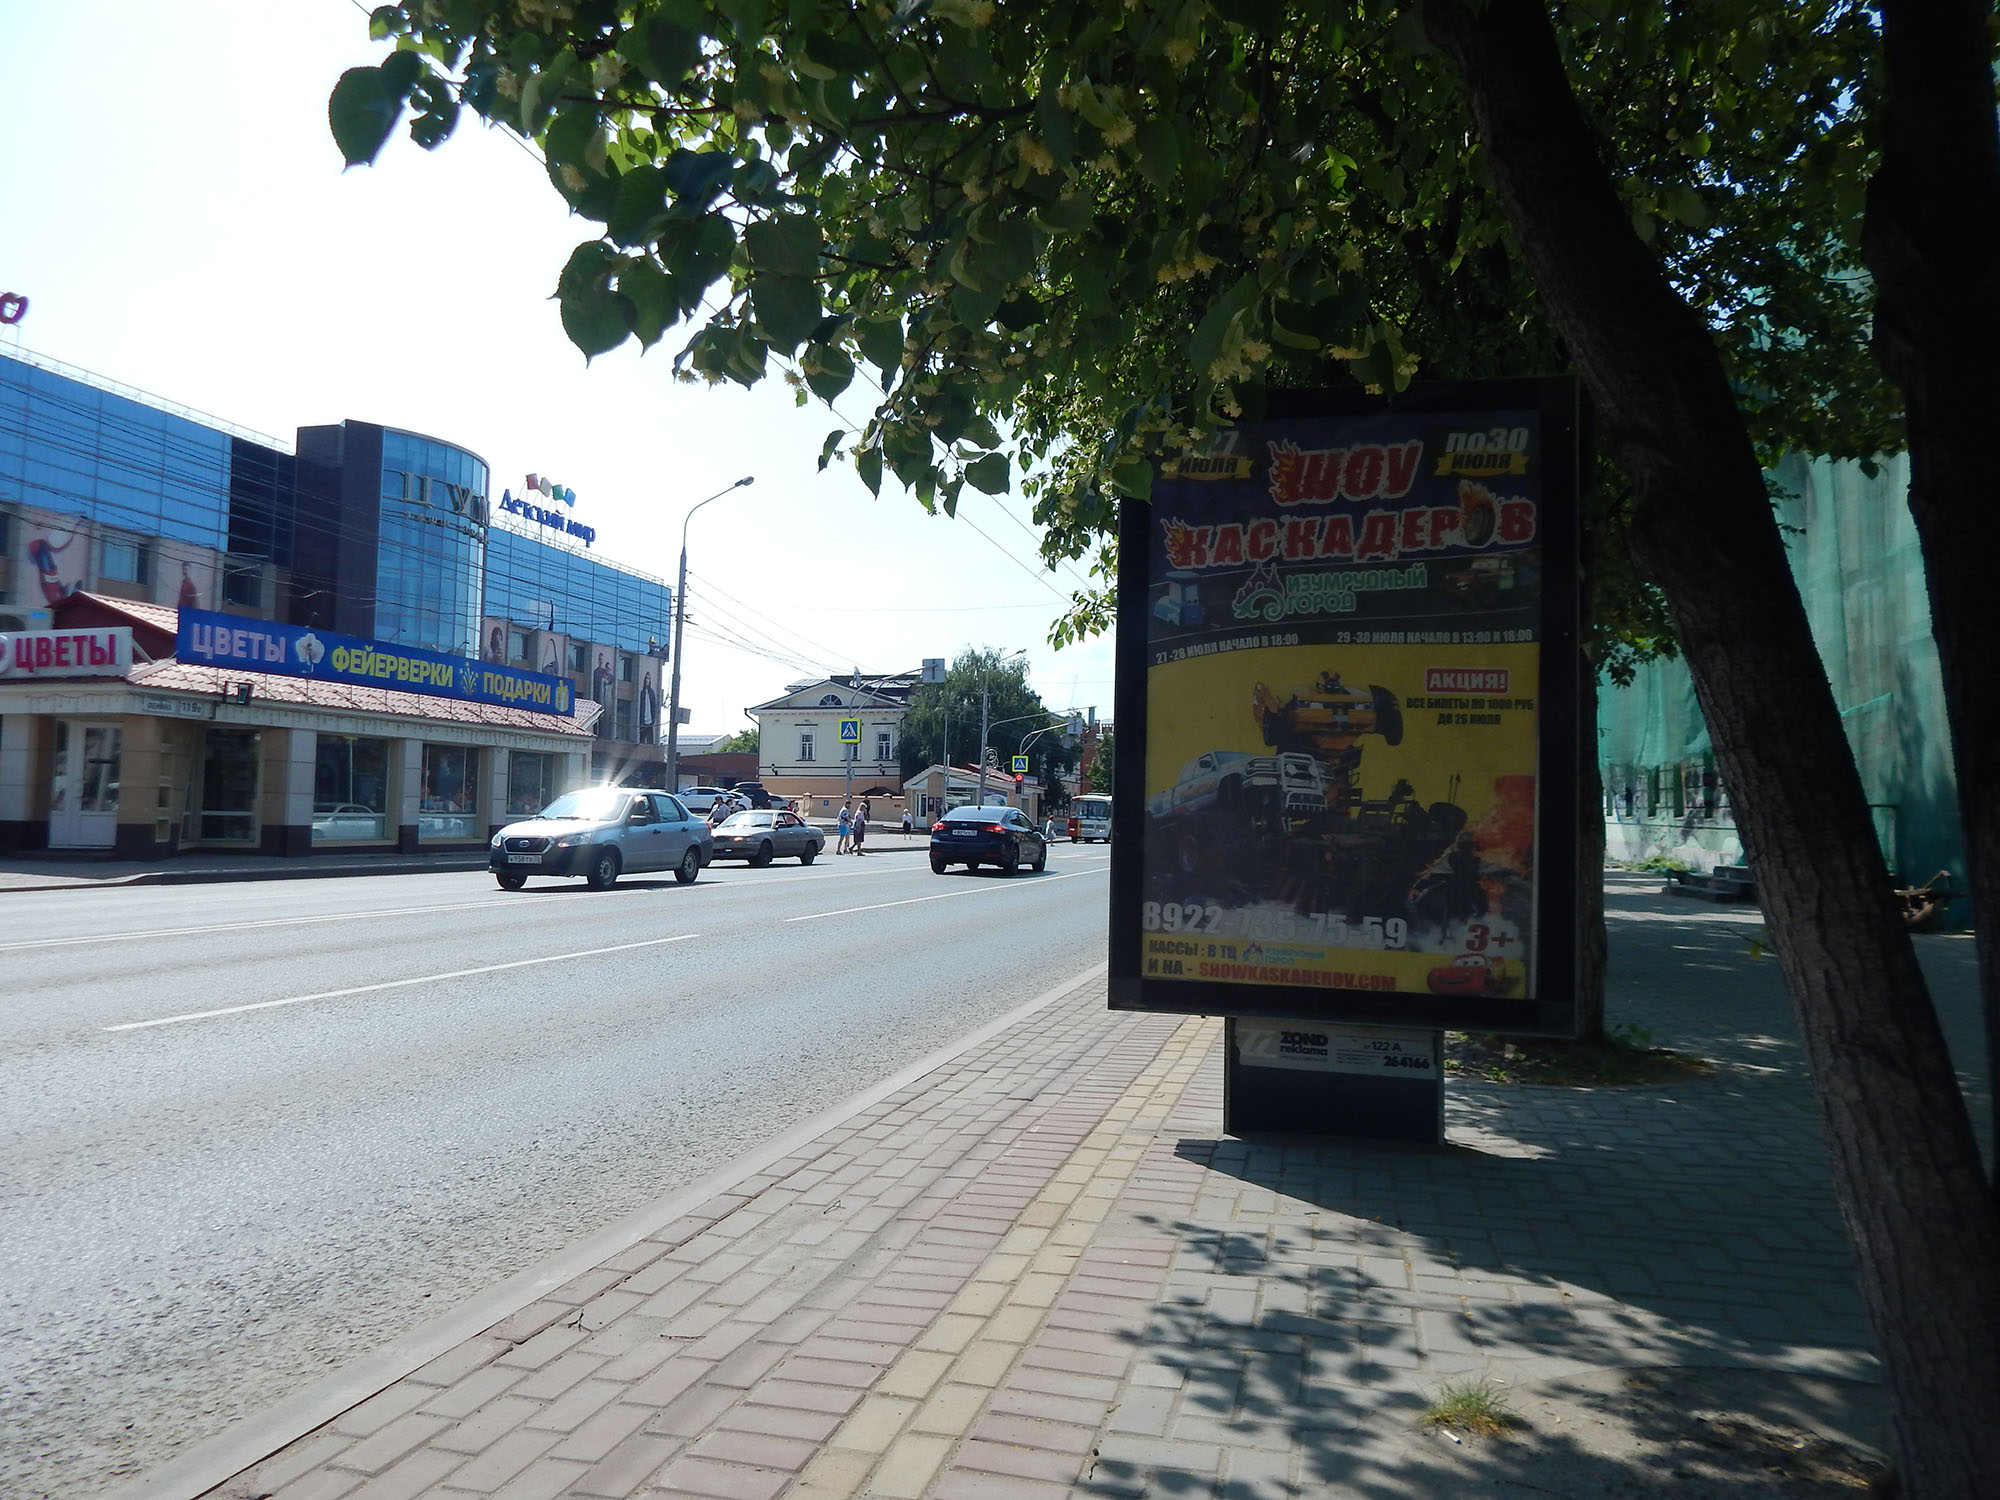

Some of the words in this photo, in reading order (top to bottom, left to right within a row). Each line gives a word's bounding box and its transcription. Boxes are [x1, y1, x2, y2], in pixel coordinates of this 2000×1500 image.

[1445, 427, 1529, 453] по30
[1179, 458, 1238, 472] ИЮЛЯ
[1452, 454, 1512, 469] ИЮЛЯ
[1267, 439, 1423, 506] ШОУ
[499, 489, 565, 530] Детский
[566, 519, 596, 548] мир
[1286, 563, 1427, 593] ИЗУМРУДНЫЙ
[1286, 591, 1356, 614] ГОРОД
[1187, 641, 1217, 657] ИЮЛЯ
[1219, 635, 1259, 652] НАЧАЛО
[1261, 637, 1269, 647] В
[1270, 633, 1299, 647] 18:00
[1372, 631, 1404, 644] ИЮЛЯ
[1406, 631, 1450, 644] НАЧАЛО
[1452, 631, 1460, 643] В
[15, 633, 116, 673] ЦВЕТЫ
[192, 622, 287, 664] ЦВЕТЫ
[331, 645, 454, 688] ФЕЙЕРВЕРКИ
[483, 671, 551, 705] ПОДАРКИ
[1430, 672, 1506, 690] АКЦИЯ!
[1407, 698, 1425, 709] ВСЕ
[1427, 698, 1469, 710] БИЛЕТЫ
[1437, 713, 1453, 726] ДО
[1465, 924, 1514, 952] 3+
[1207, 944, 1217, 957] В
[1219, 944, 1237, 961] ТЦ
[1147, 959, 1160, 974] И
[1162, 959, 1184, 974] НА
[1199, 962, 1397, 991] SHOWKASKADEROV.COM
[1280, 1031, 1329, 1047] ZOND
[1280, 1043, 1328, 1056] reklama
[1383, 1055, 1430, 1070] 264166
